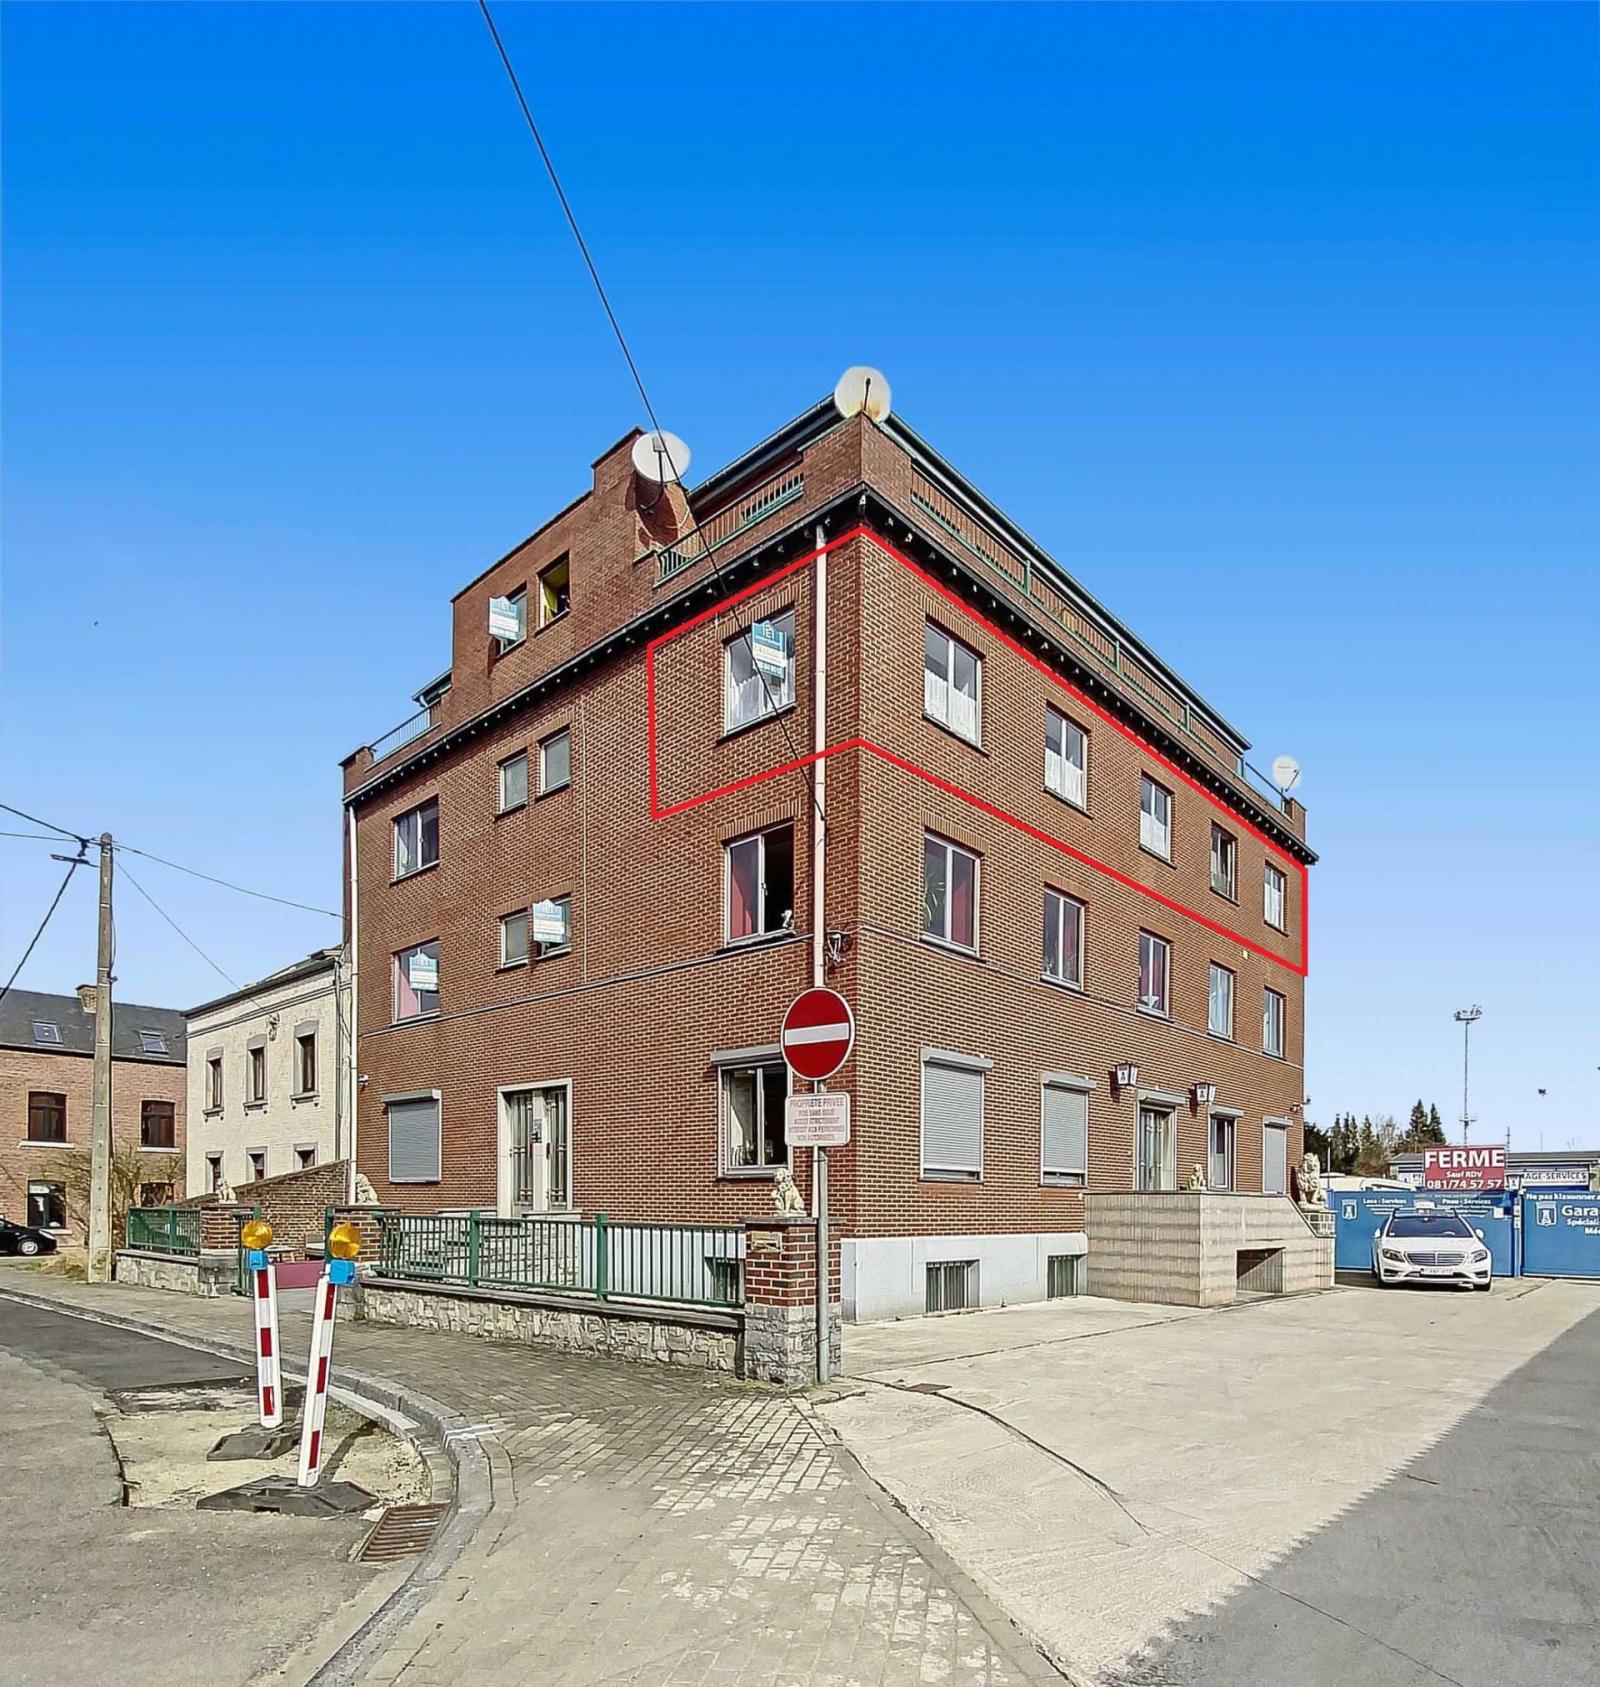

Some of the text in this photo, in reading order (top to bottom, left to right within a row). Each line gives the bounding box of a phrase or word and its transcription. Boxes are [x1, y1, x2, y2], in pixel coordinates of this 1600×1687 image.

[1425, 1150, 1505, 1168] FERME
[1446, 1170, 1483, 1178] Sauf RDV
[1427, 1179, 1503, 1189] 081/74 57 57
